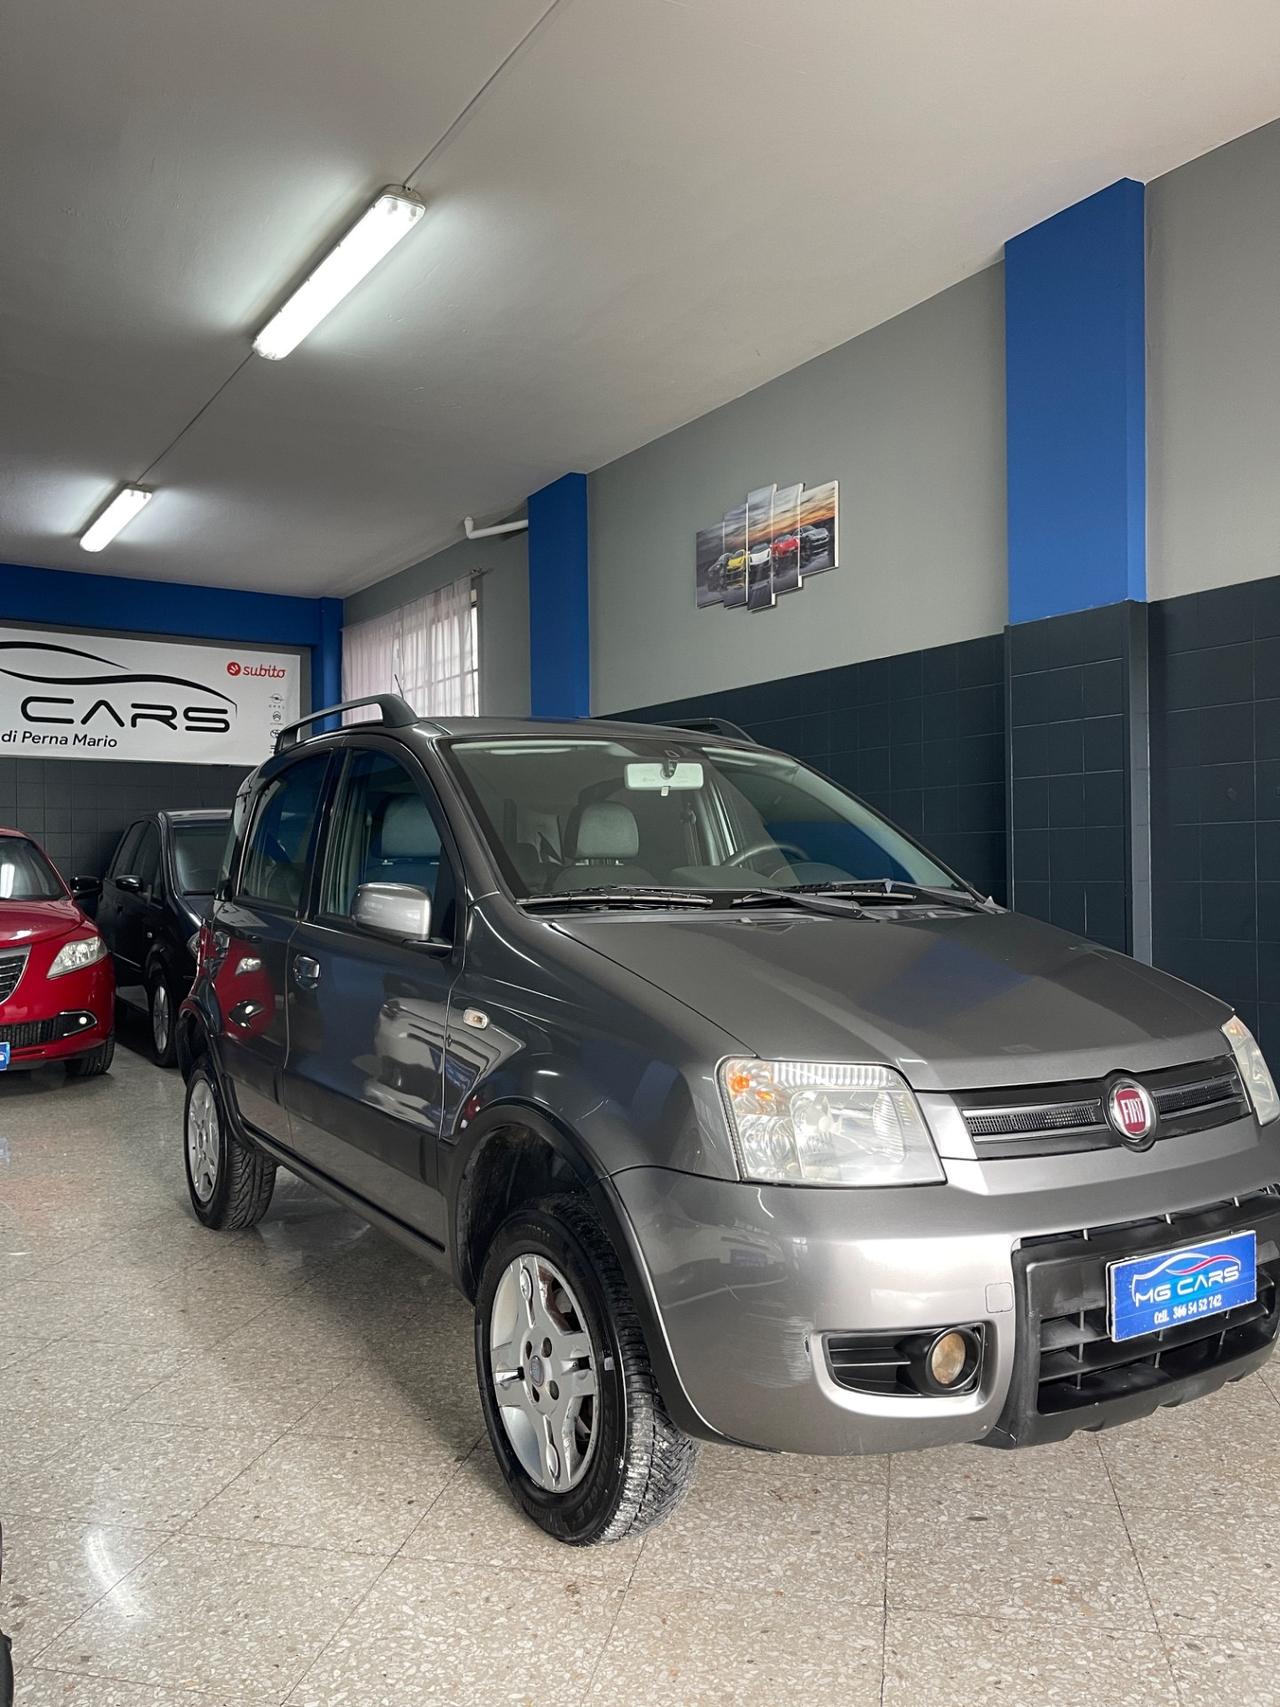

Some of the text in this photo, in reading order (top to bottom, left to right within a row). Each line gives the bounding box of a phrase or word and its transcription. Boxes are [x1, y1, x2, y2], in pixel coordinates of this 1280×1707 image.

[243, 664, 286, 679] subito
[20, 696, 230, 733] CARS
[1, 730, 118, 748] di Perna Mario
[1135, 1265, 1239, 1308] MG CARS
